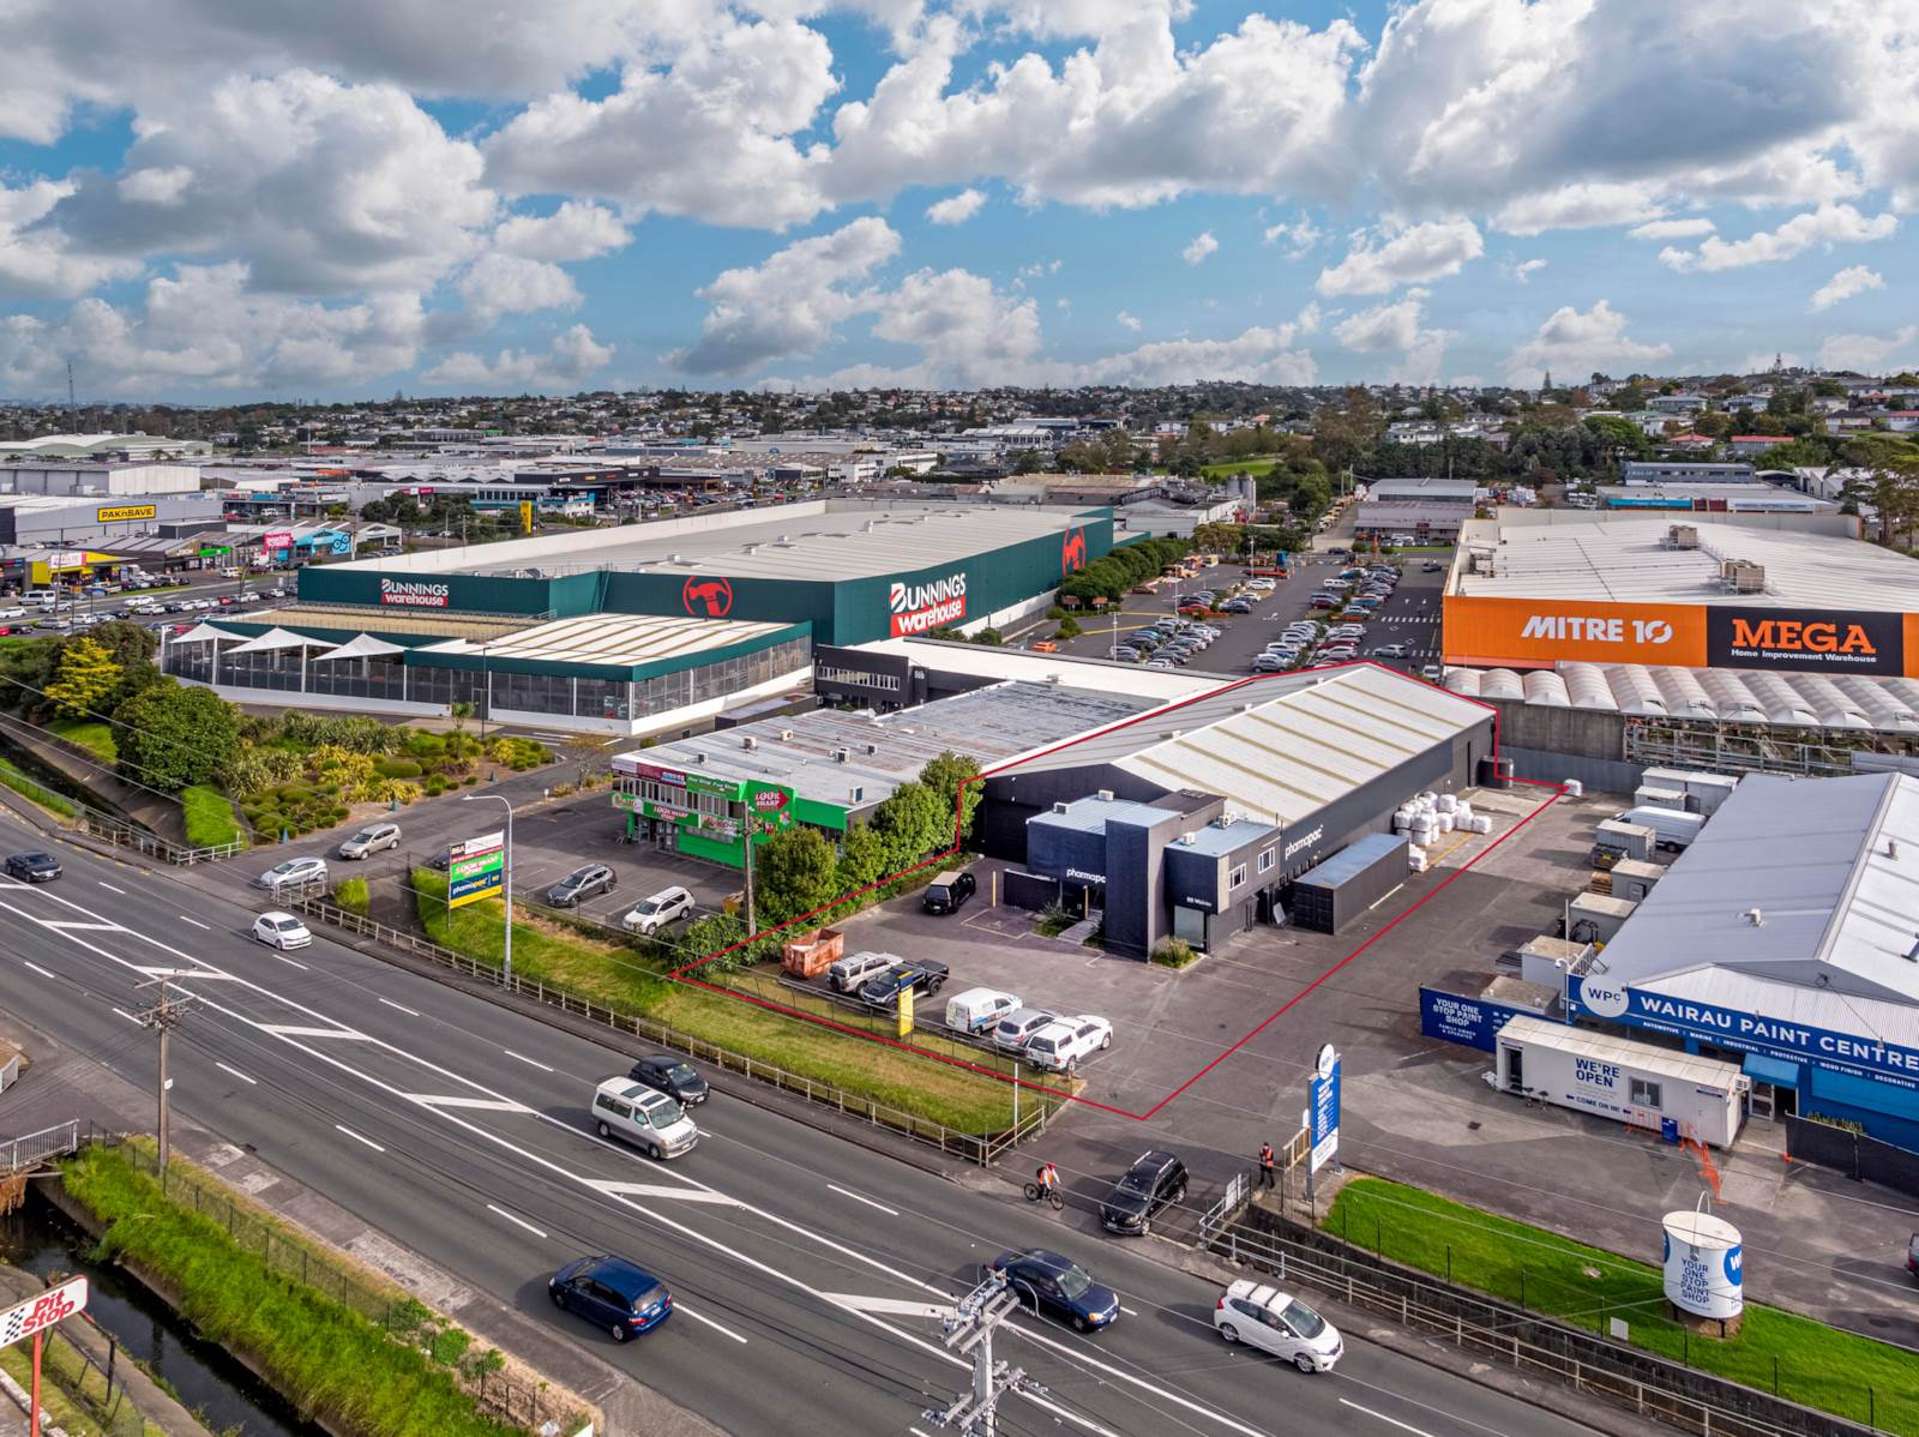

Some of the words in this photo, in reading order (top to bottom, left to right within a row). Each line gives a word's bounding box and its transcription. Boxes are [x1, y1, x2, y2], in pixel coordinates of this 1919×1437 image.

[381, 578, 449, 597] BUNNINGS
[890, 572, 966, 613] BUNNINGS
[384, 593, 444, 606] warehouse
[898, 600, 962, 633] warehouse
[1520, 615, 1624, 642] MITRE
[1631, 619, 1673, 644] 10
[1731, 618, 1877, 654] MEGA
[1731, 648, 1758, 657] Home
[1762, 650, 1822, 660] Improvement
[1825, 653, 1877, 663] Warehouse
[1285, 829, 1322, 860] pharmapac
[1433, 1004, 1455, 1015] STOP
[1457, 1010, 1482, 1023] PAINT
[1436, 998, 1460, 1010] YOUR
[1461, 1004, 1479, 1014] ONE
[1445, 1015, 1469, 1027] SHOP
[1640, 996, 1732, 1028] WAIRAU
[1740, 1018, 1810, 1046] PAINT
[1819, 1036, 1919, 1070] CENTRE
[1643, 1021, 1679, 1034] AUTOMOTIVE
[1690, 1032, 1712, 1042] MARINE
[1723, 1039, 1759, 1053] INDUSTRIAL
[1770, 1051, 1808, 1063] PROTECTIVE
[1840, 1066, 1863, 1076] FINISH
[1576, 1057, 1620, 1078] WE'RE
[1576, 1070, 1613, 1088] OPEN
[1576, 1096, 1596, 1106] COME
[1682, 1257, 1708, 1272] YOUR
[1684, 1267, 1707, 1280] ONE
[1680, 1281, 1709, 1296] PAINT
[1682, 1274, 1708, 1288] STOP
[33, 1289, 65, 1316] Pit
[1682, 1289, 1710, 1304] SHOP
[21, 1301, 75, 1334] Stop
